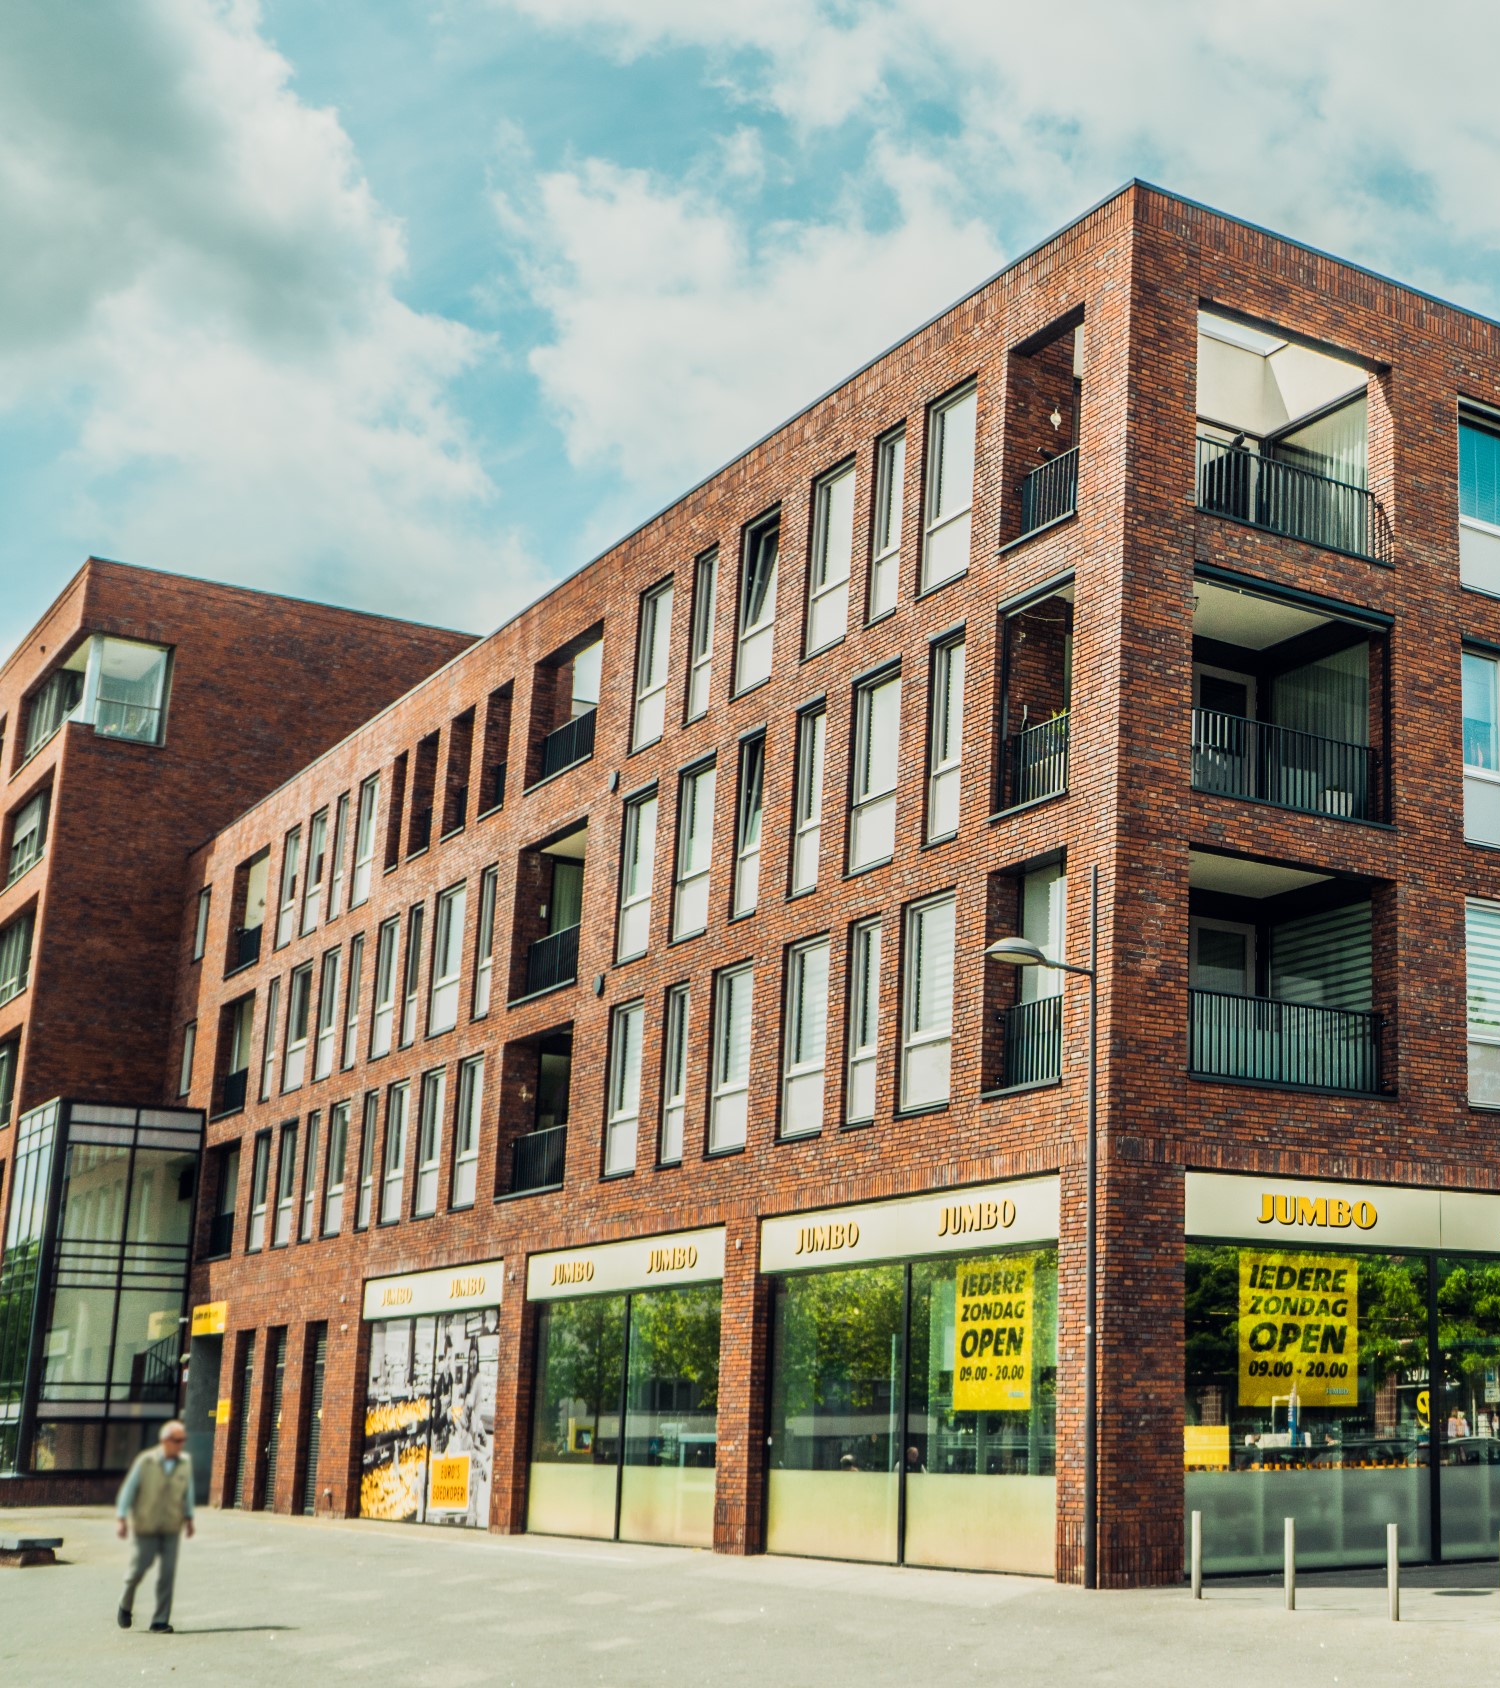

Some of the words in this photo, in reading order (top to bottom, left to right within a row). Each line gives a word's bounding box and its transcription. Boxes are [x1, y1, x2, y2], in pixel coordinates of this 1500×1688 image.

[937, 1198, 1016, 1237] JUMBO
[1257, 1193, 1377, 1230] JUMBO
[795, 1221, 860, 1255] JUMBO
[551, 1260, 594, 1286] JUMBO
[646, 1245, 698, 1274] JUMBO
[449, 1275, 486, 1299] JUMBO
[961, 1269, 1027, 1298] IEDERE
[1249, 1263, 1348, 1293] IEDERE
[381, 1287, 413, 1307] JUMBO
[961, 1301, 1025, 1322] ZONDAG
[1249, 1295, 1348, 1318] ZONDAG
[960, 1326, 1025, 1358] OPEN
[1249, 1321, 1348, 1354] OPEN
[960, 1366, 988, 1382] 09.00
[995, 1365, 1025, 1381] 20.00
[1249, 1360, 1293, 1378] 09.00
[1305, 1361, 1348, 1378] 20.00
